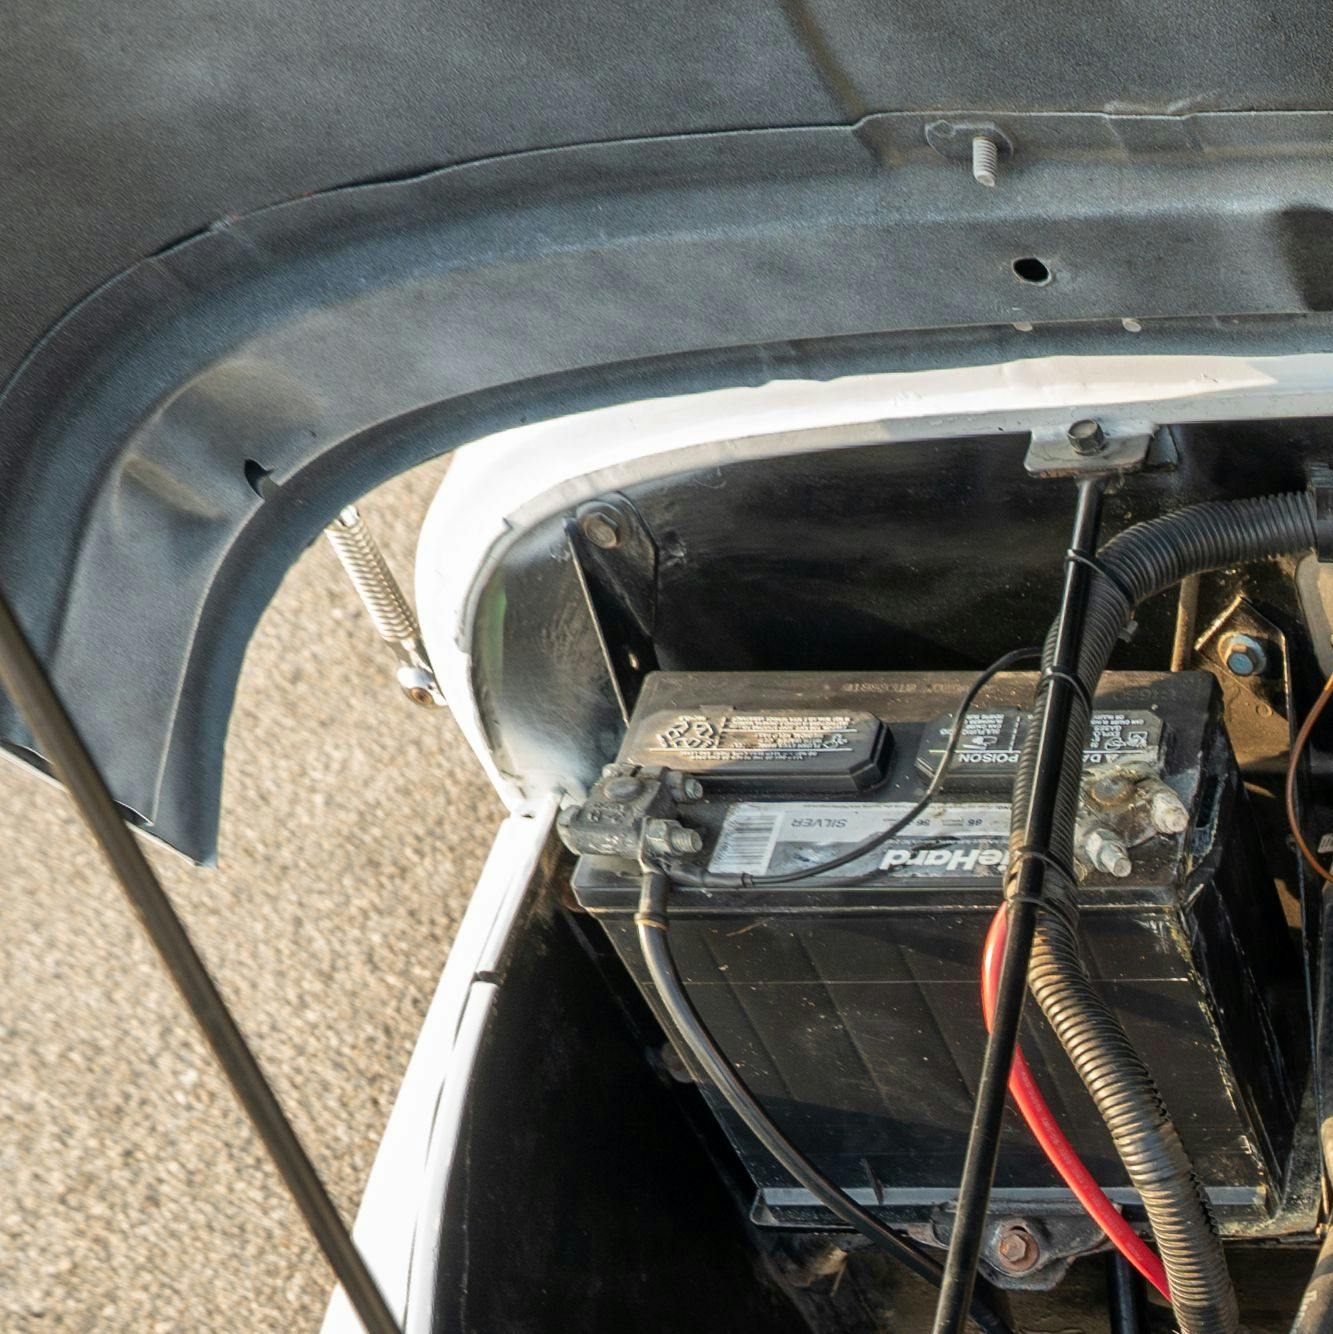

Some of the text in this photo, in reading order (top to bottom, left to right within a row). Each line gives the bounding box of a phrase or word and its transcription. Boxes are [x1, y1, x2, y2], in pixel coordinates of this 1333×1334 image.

[959, 753, 1020, 763] POISON
[790, 817, 848, 829] SILVER
[880, 848, 1010, 871] ieHard
